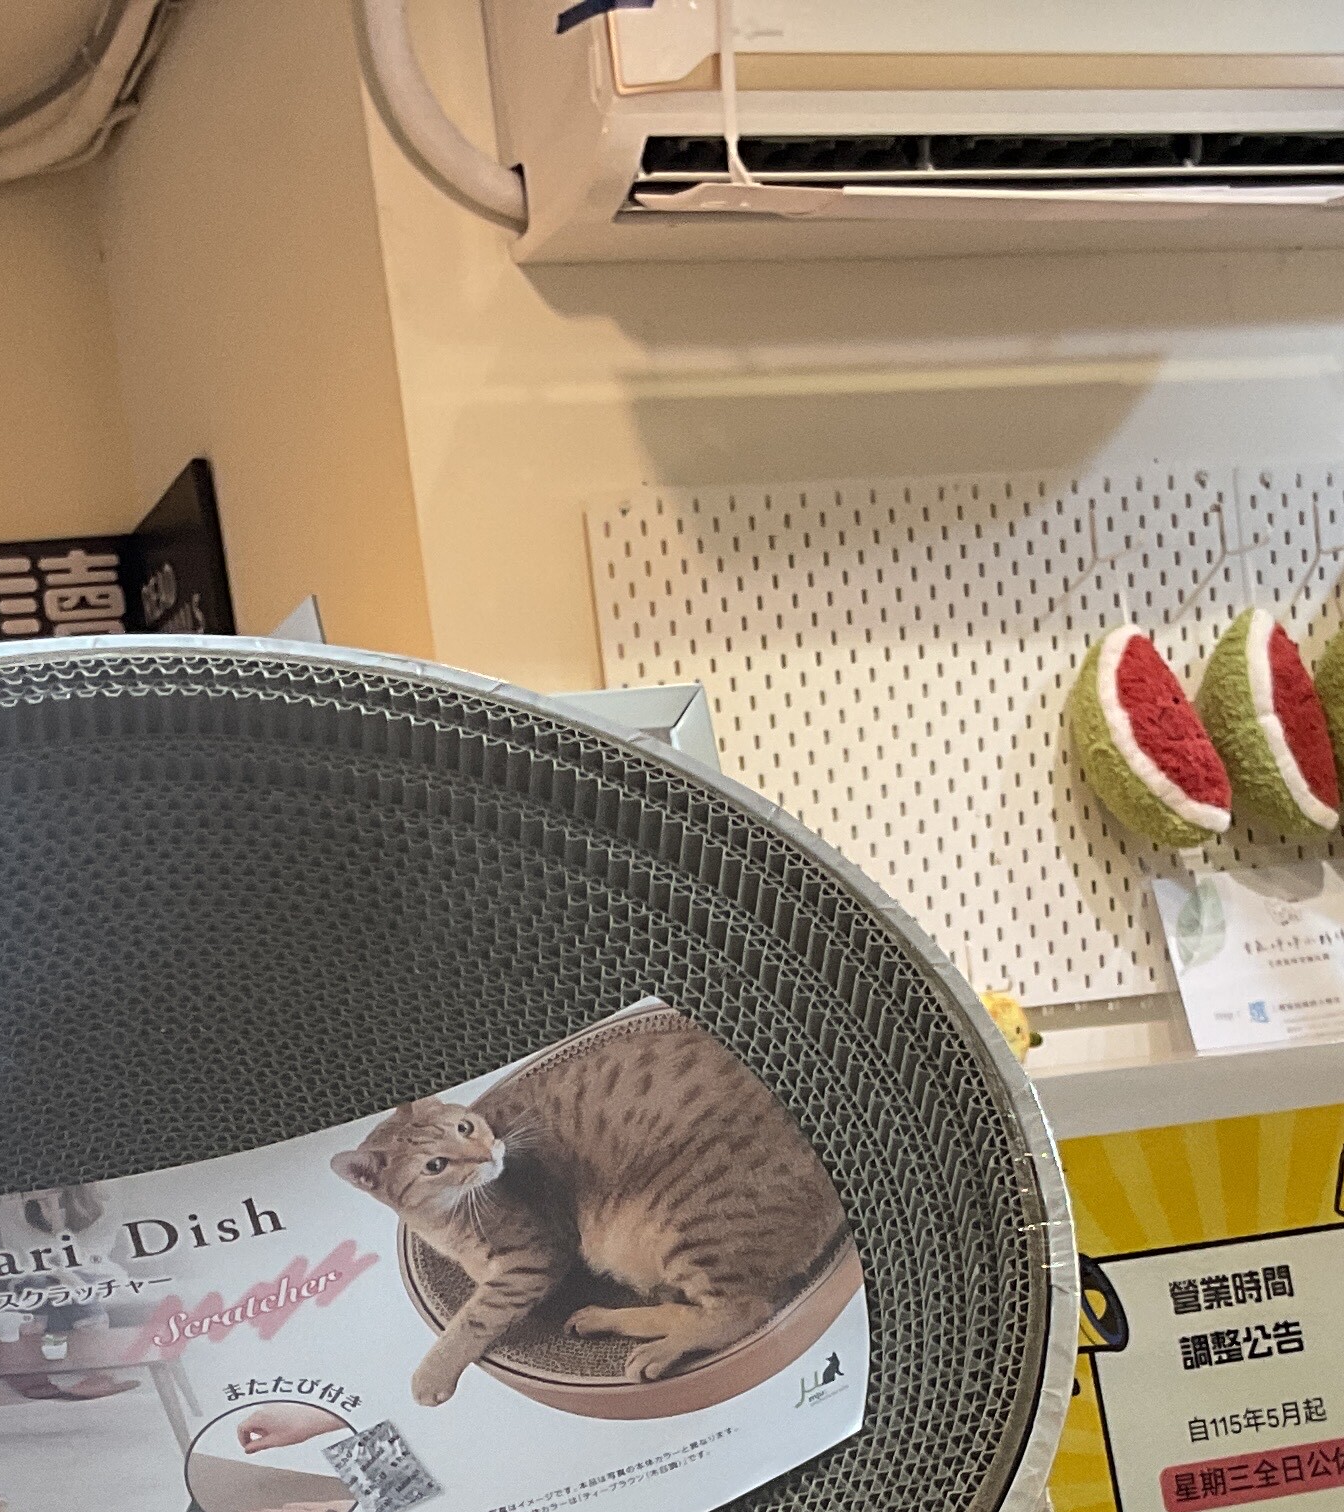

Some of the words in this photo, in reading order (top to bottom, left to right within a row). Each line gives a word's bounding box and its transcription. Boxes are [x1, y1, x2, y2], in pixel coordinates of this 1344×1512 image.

[122, 1198, 287, 1260] Dish
[153, 1268, 342, 1348] Scratcher
[1169, 1264, 1295, 1316] 營業時間
[1178, 1320, 1305, 1371] 調整公告
[222, 1376, 363, 1413] またたび付き
[1188, 1397, 1328, 1443] 自115年5月起
